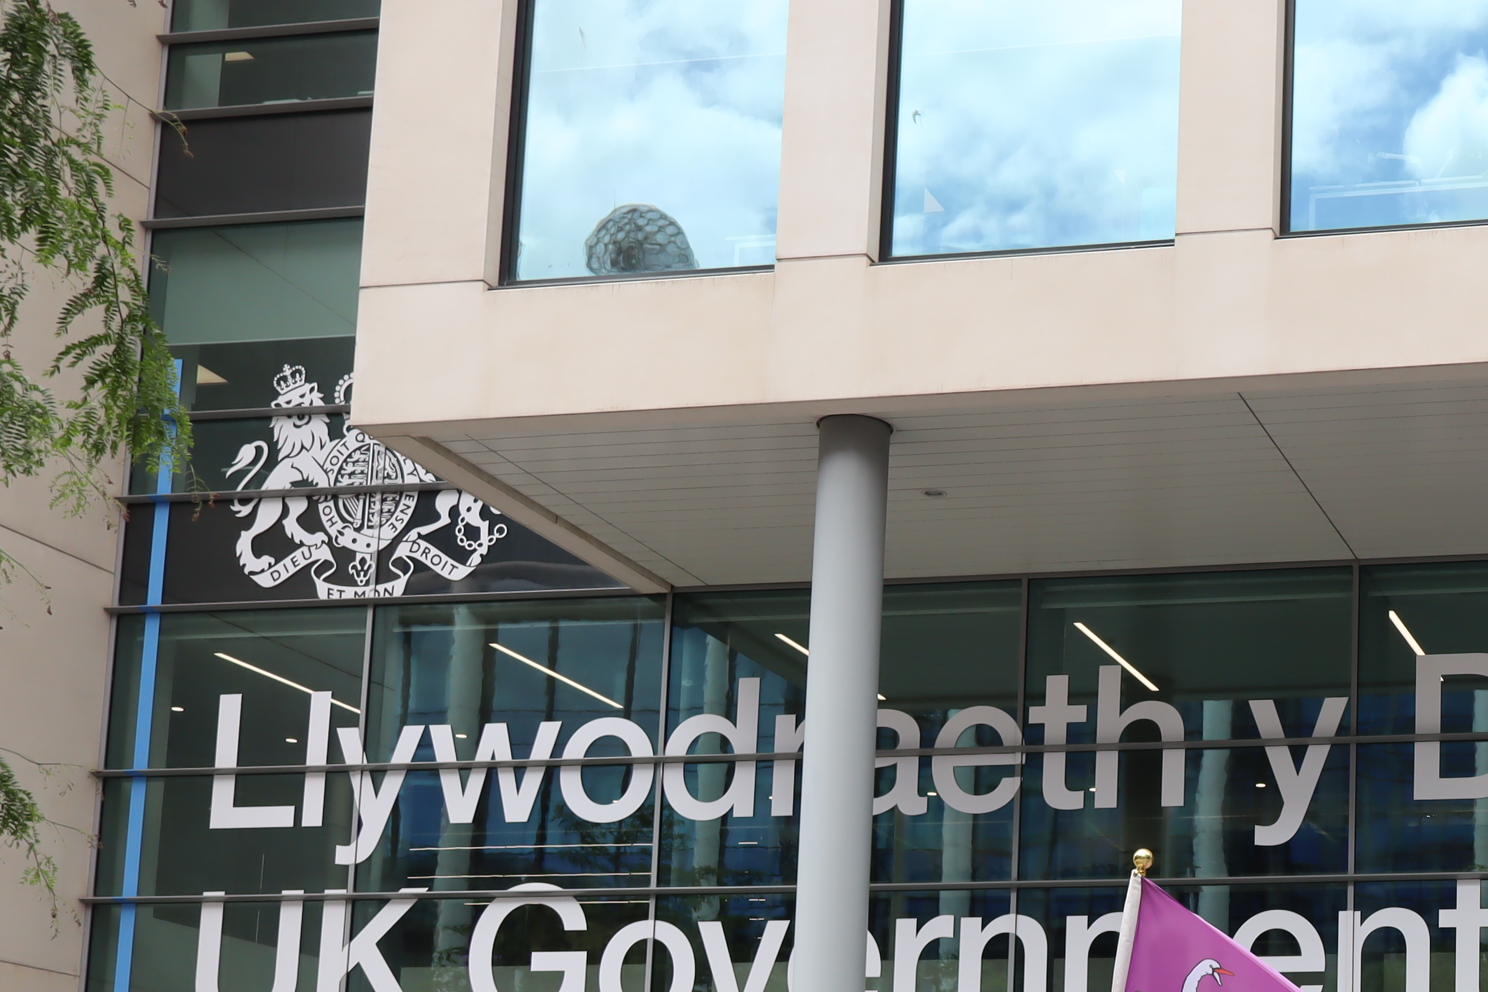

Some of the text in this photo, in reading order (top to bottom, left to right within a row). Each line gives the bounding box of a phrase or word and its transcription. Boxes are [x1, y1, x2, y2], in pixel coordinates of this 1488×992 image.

[324, 440, 350, 476] SOIT
[269, 539, 460, 599] DIEU ET MON DROIT
[1248, 696, 1349, 847] y
